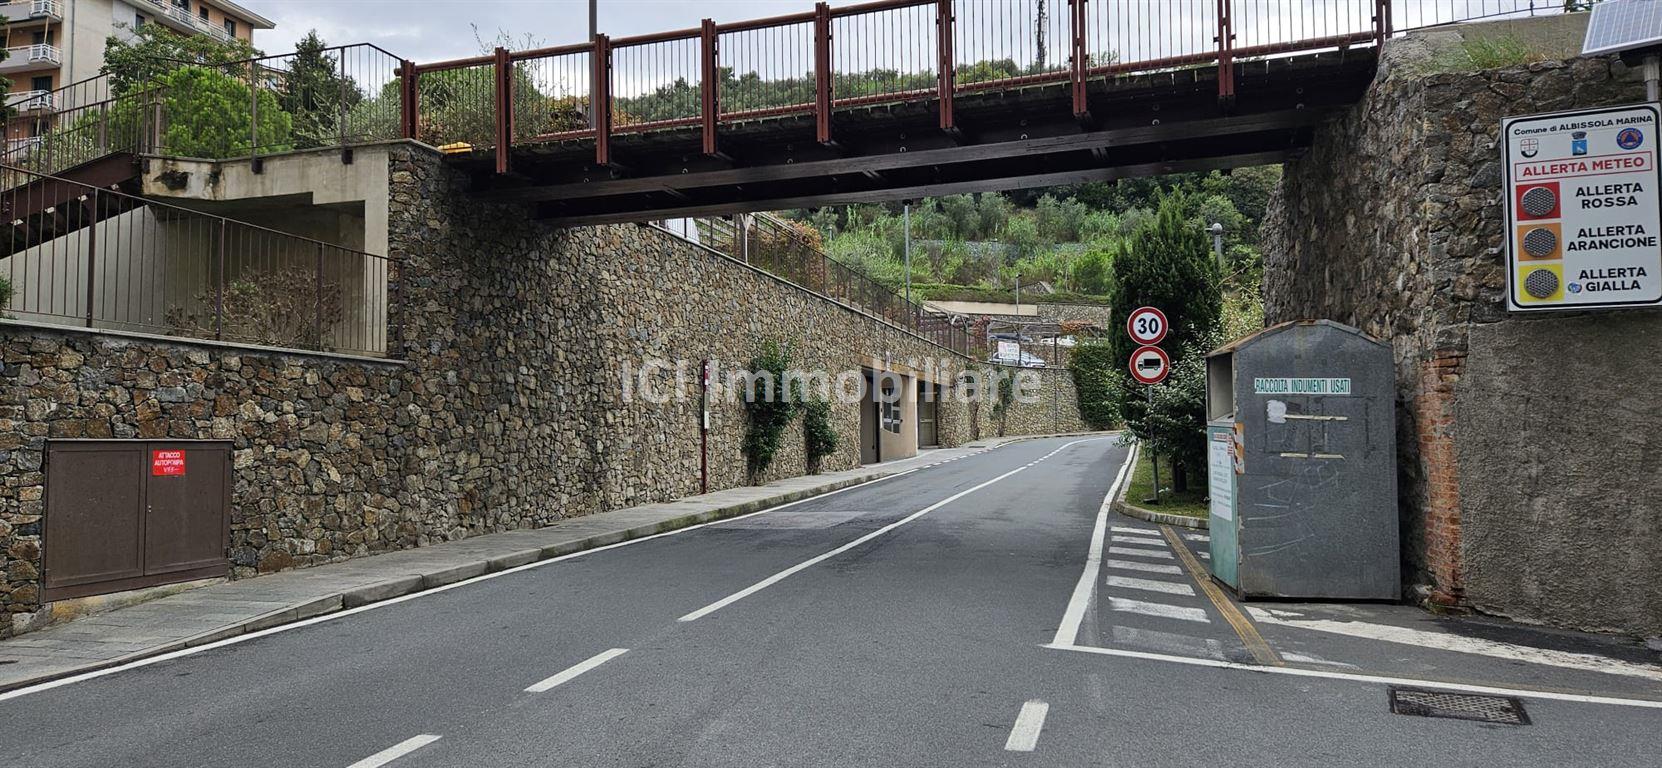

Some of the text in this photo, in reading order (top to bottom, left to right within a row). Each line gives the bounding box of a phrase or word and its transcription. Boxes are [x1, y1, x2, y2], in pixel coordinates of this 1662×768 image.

[1514, 127, 1547, 135] Comune
[1559, 119, 1614, 131] ALBISSOLA
[1616, 115, 1652, 125] MARINA
[1523, 157, 1644, 176] ALLERTA METEO
[1576, 183, 1643, 197] ALLERTA
[1582, 196, 1638, 209] ROSSA
[1578, 225, 1645, 238] ALLERTA
[1567, 237, 1657, 251] ARANCIONE
[1579, 267, 1646, 279] ALLERTA
[1586, 279, 1641, 292] GIALLA
[1137, 318, 1159, 334] 30
[1255, 378, 1350, 392] RACCOLTA INDUMENTI USATI
